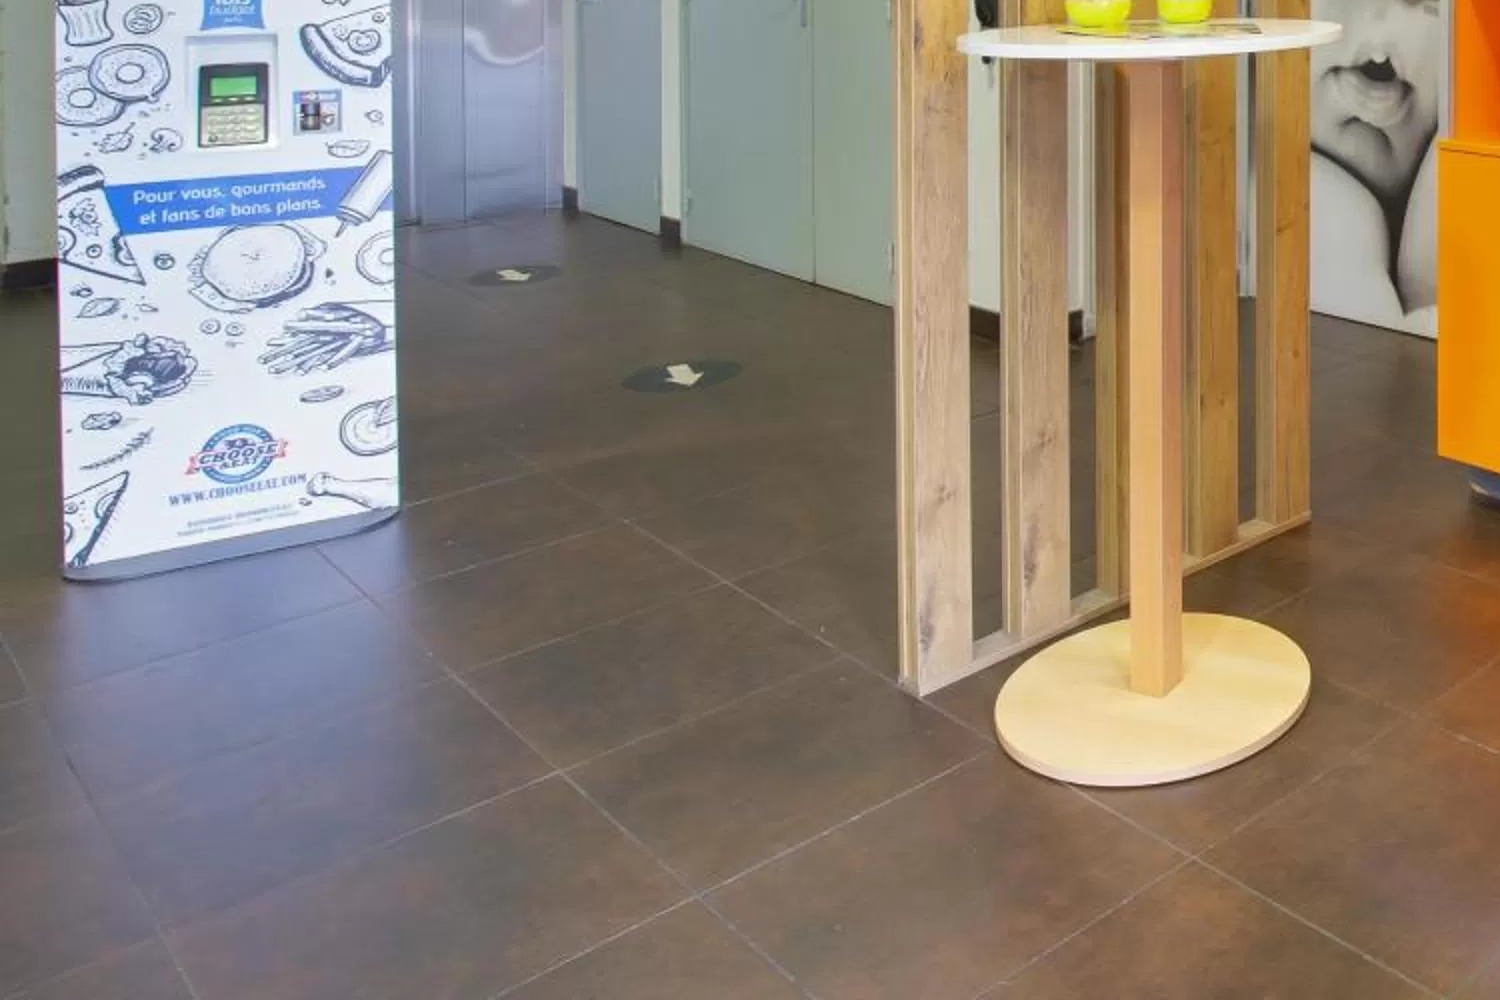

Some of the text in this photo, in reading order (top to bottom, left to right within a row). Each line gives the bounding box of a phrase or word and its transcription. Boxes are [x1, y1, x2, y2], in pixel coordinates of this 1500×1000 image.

[133, 189, 177, 205] Pour
[231, 176, 327, 198] gourmands
[139, 211, 157, 225] et
[161, 207, 201, 224] fans
[205, 203, 226, 219] de
[231, 201, 273, 217] bons
[199, 443, 279, 465] CHOOSE
